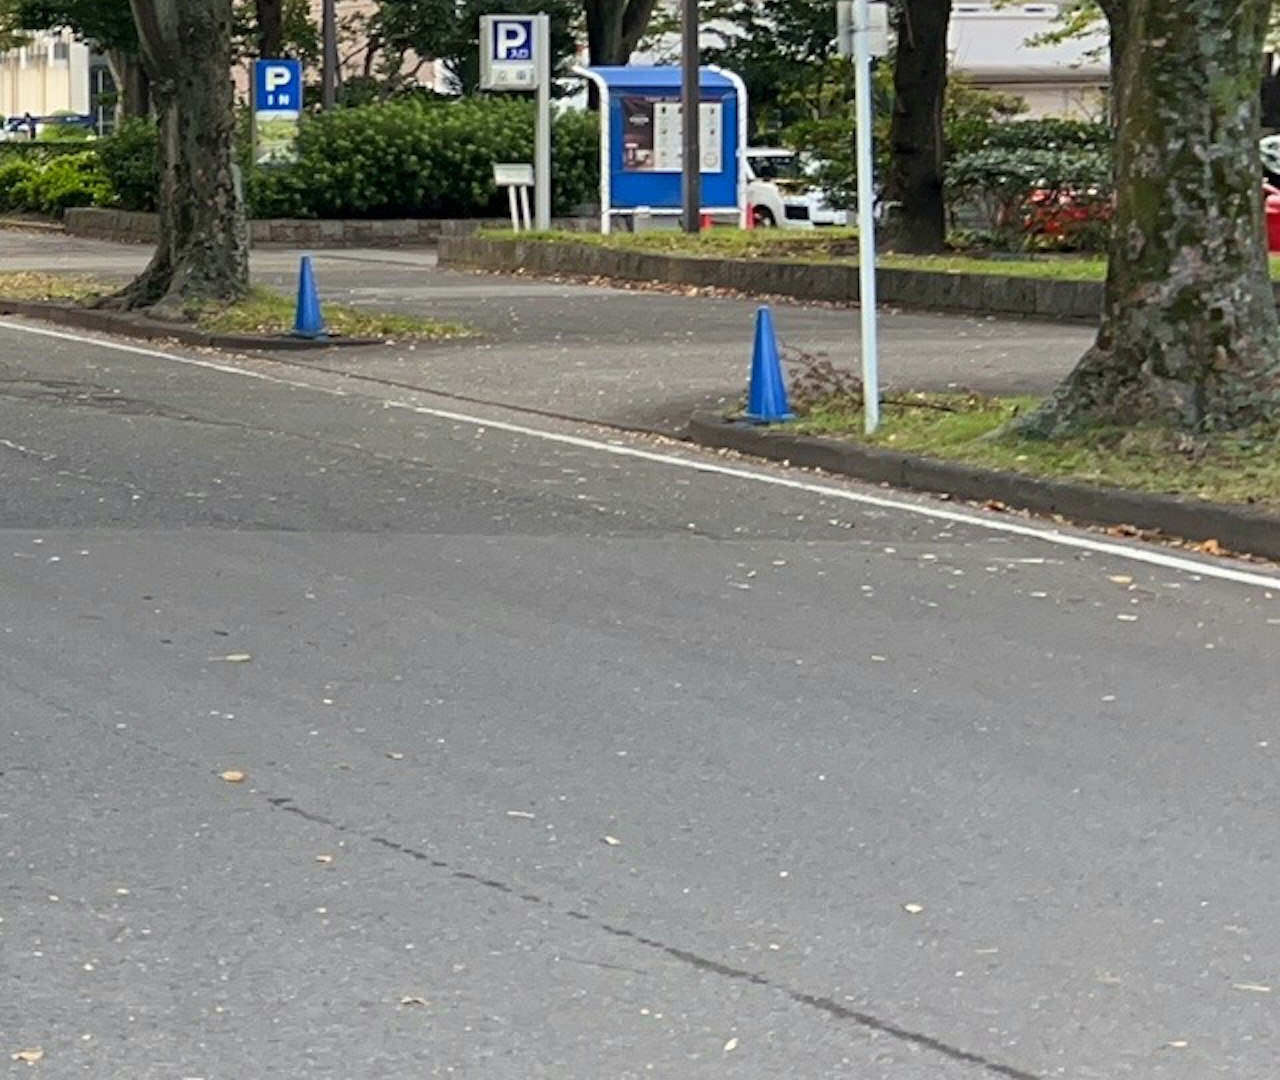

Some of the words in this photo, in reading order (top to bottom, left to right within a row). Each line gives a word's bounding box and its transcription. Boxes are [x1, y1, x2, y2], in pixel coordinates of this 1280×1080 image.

[497, 23, 527, 59] P
[265, 66, 291, 91] P
[267, 94, 290, 106] IN
